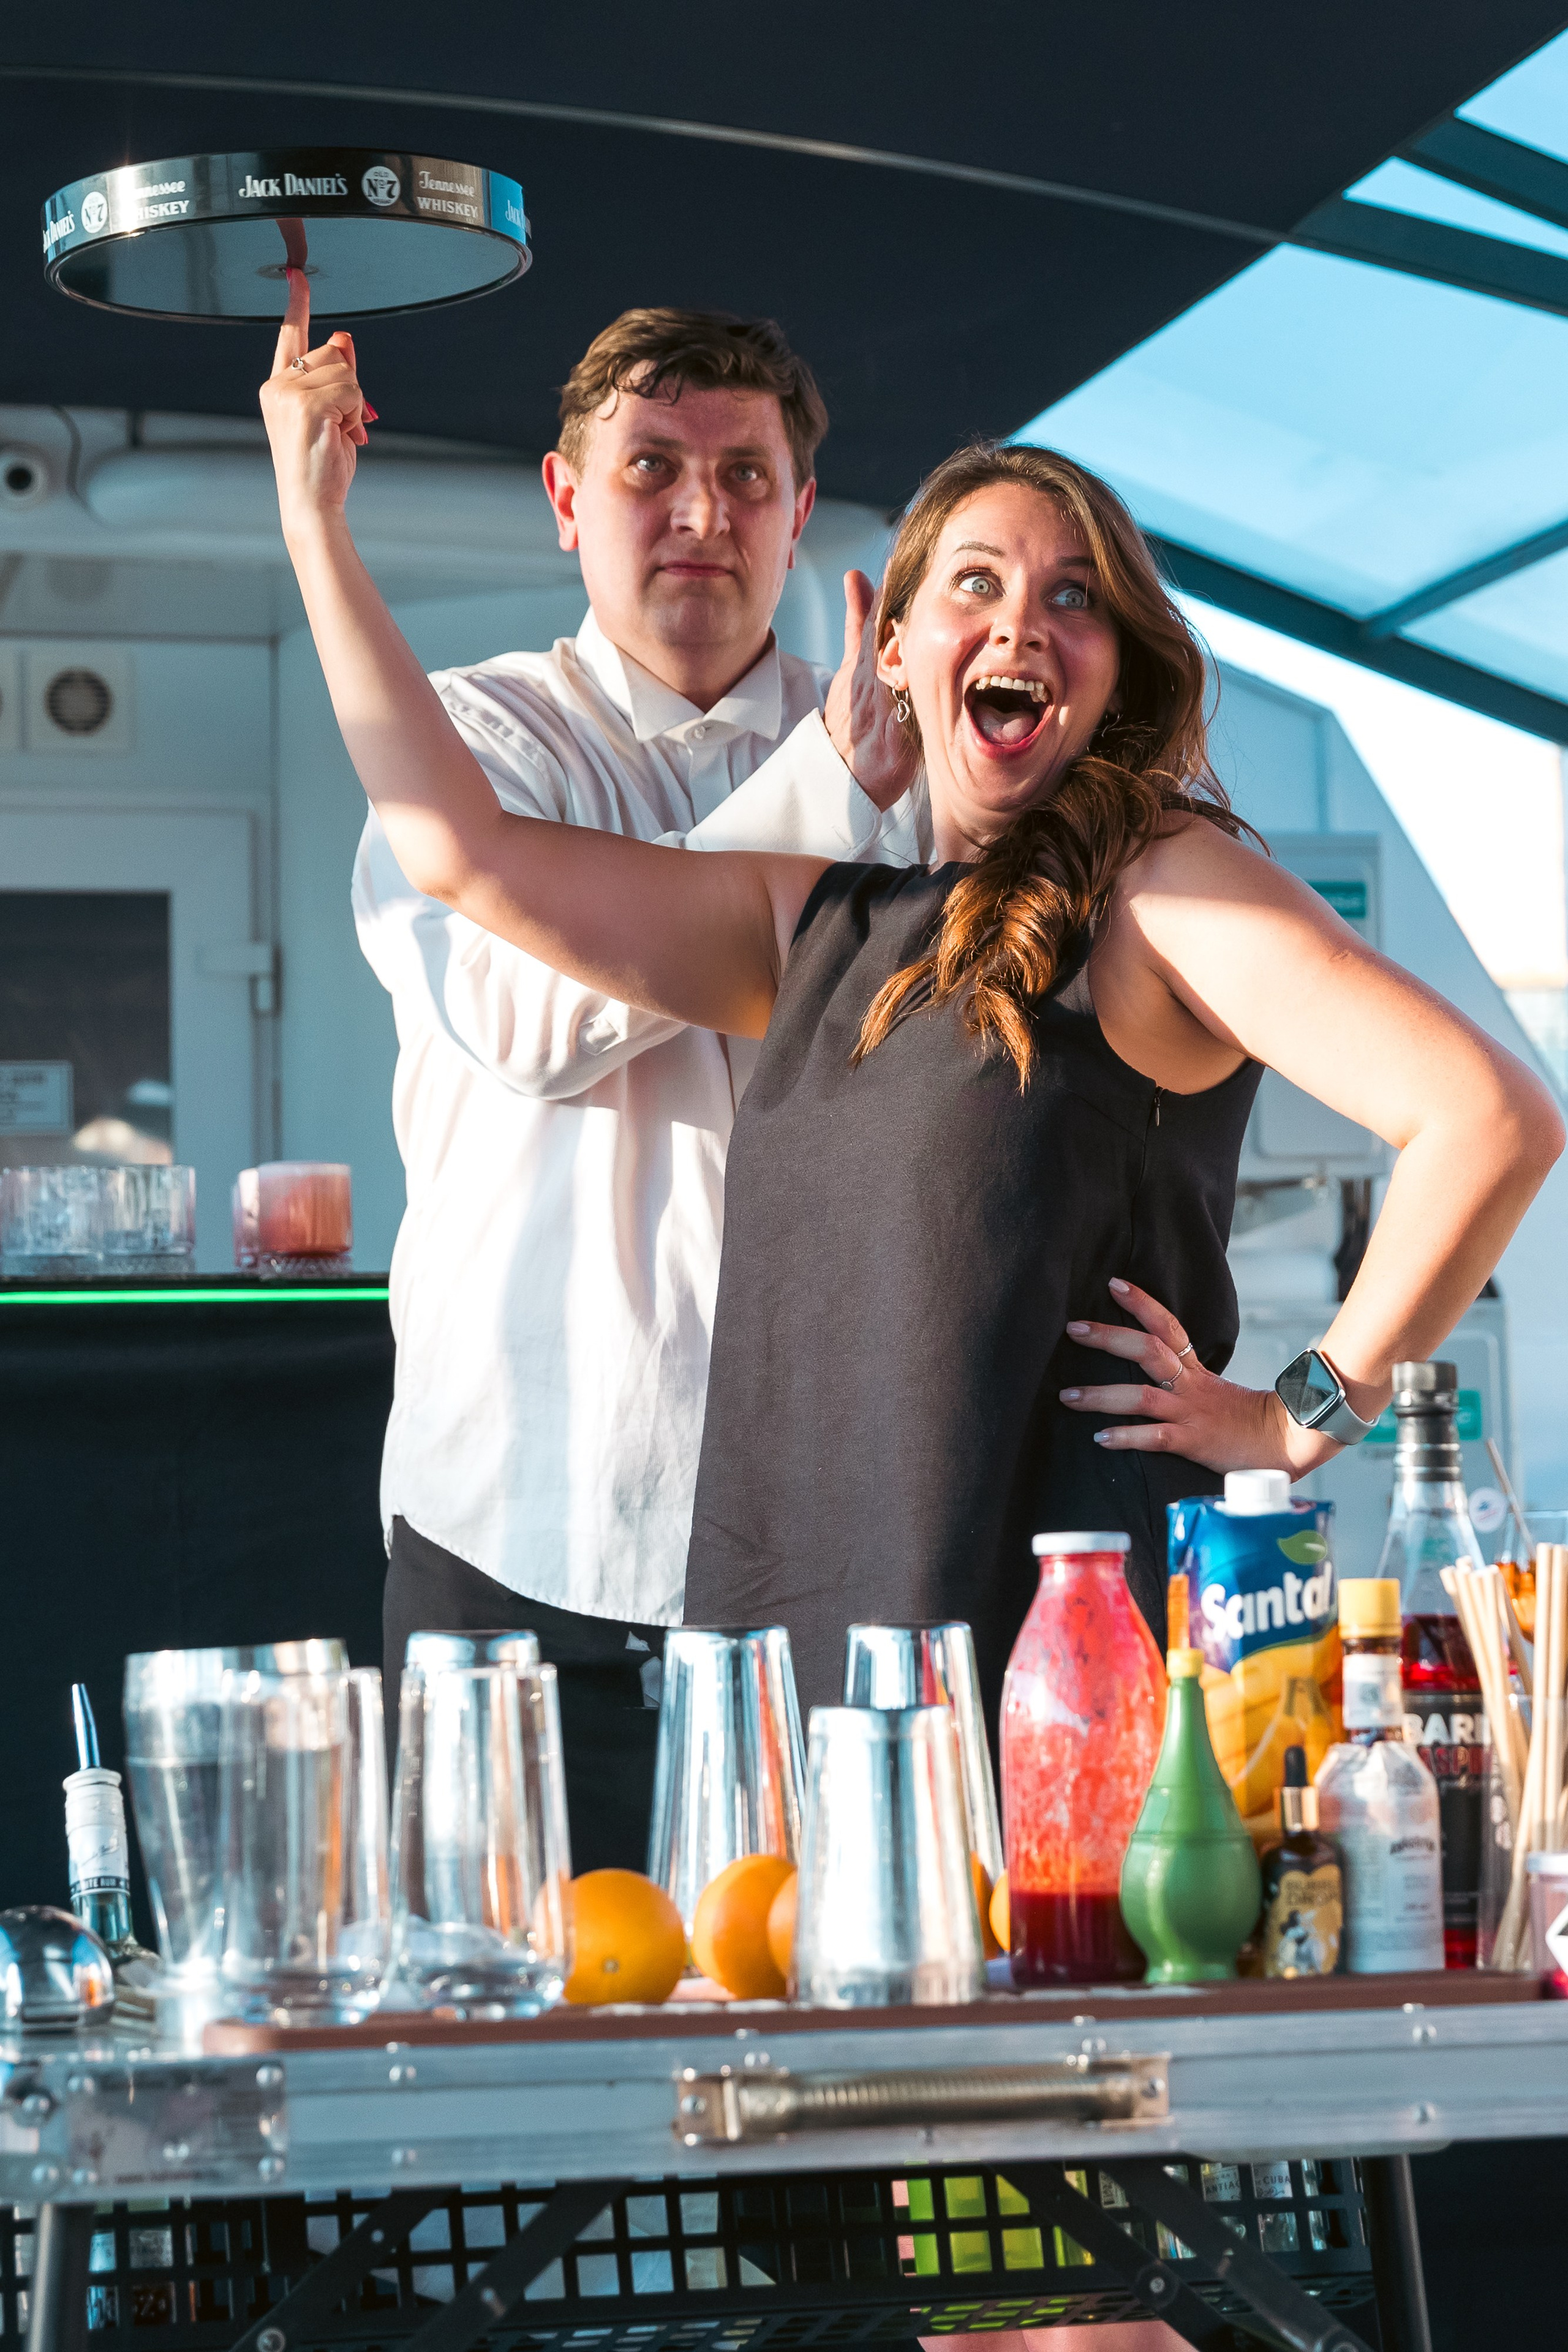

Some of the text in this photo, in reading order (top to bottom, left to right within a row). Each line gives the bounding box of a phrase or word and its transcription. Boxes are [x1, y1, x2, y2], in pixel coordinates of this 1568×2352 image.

[238, 173, 349, 198] JACK DANIEL'S
[418, 171, 475, 198] Tennessee
[135, 200, 190, 221] HISKEY
[417, 197, 478, 218] WHISKEY
[1201, 1562, 1333, 1642] Santal
[1264, 2175, 1291, 2185] CUBA
